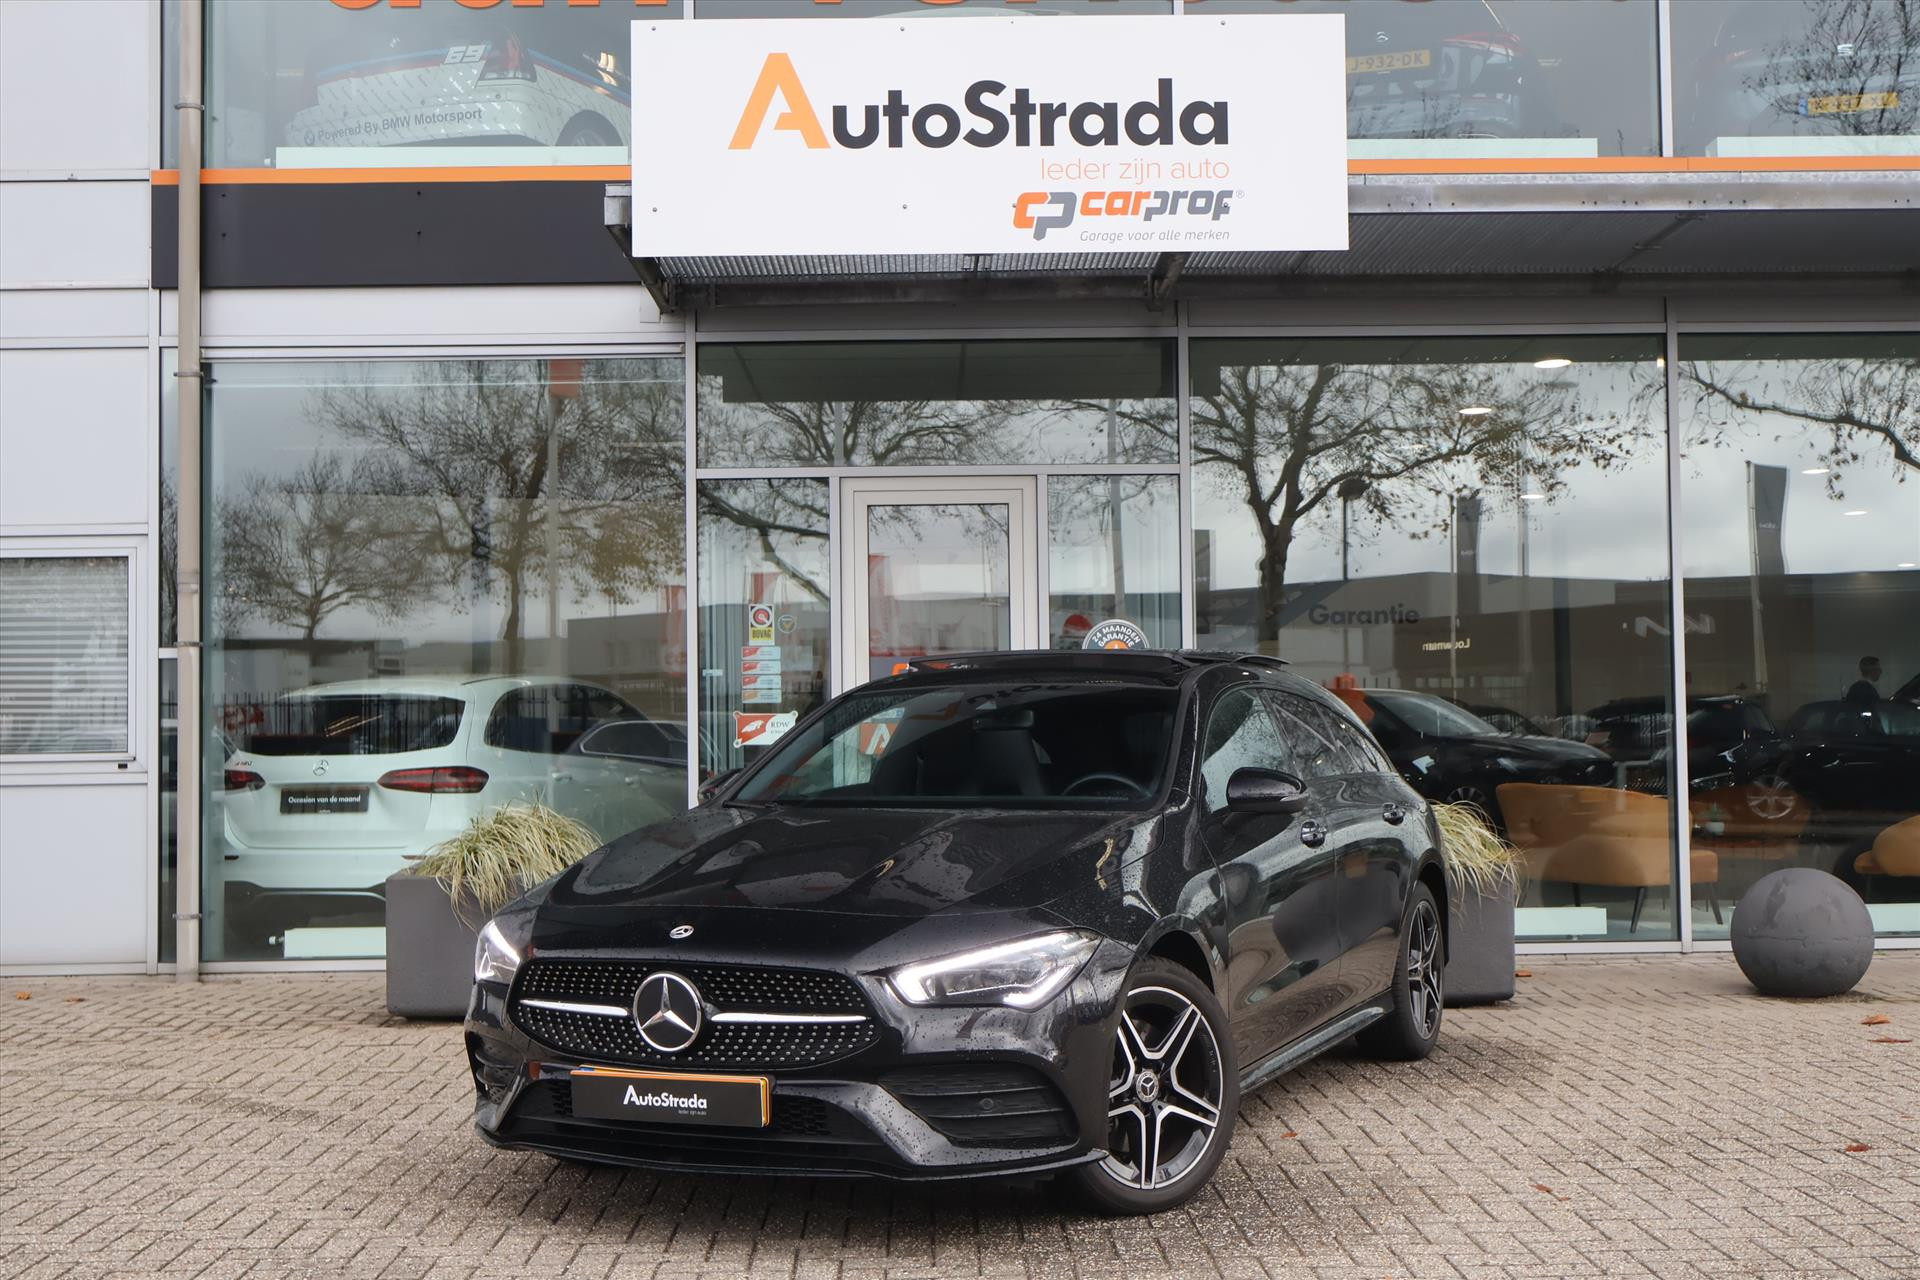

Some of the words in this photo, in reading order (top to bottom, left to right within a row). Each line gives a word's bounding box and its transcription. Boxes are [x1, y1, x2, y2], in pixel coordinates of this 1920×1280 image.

[444, 45, 486, 65] 69
[728, 52, 1229, 149] AutoStrada
[318, 125, 362, 142] Powered
[364, 122, 379, 135] By
[382, 116, 411, 131] BMW
[414, 108, 483, 126] Motorsport
[1041, 158, 1111, 181] Ieder
[1119, 158, 1161, 185] zijn
[1170, 158, 1230, 180] auto
[1079, 190, 1234, 221] carprof
[1080, 230, 1124, 245] Garage
[1128, 231, 1155, 241] voor
[1158, 229, 1182, 241] alle
[1184, 229, 1230, 241] merken
[1308, 603, 1421, 625] Garantie
[752, 628, 772, 639] BOVAG
[1092, 632, 1102, 643] 24
[1102, 625, 1140, 643] MAANDEN
[1098, 633, 1134, 647] GARANTIE
[288, 795, 316, 804] Occasion
[329, 795, 338, 803] de
[338, 794, 361, 803] maand
[623, 1084, 708, 1109] AutoStrada
